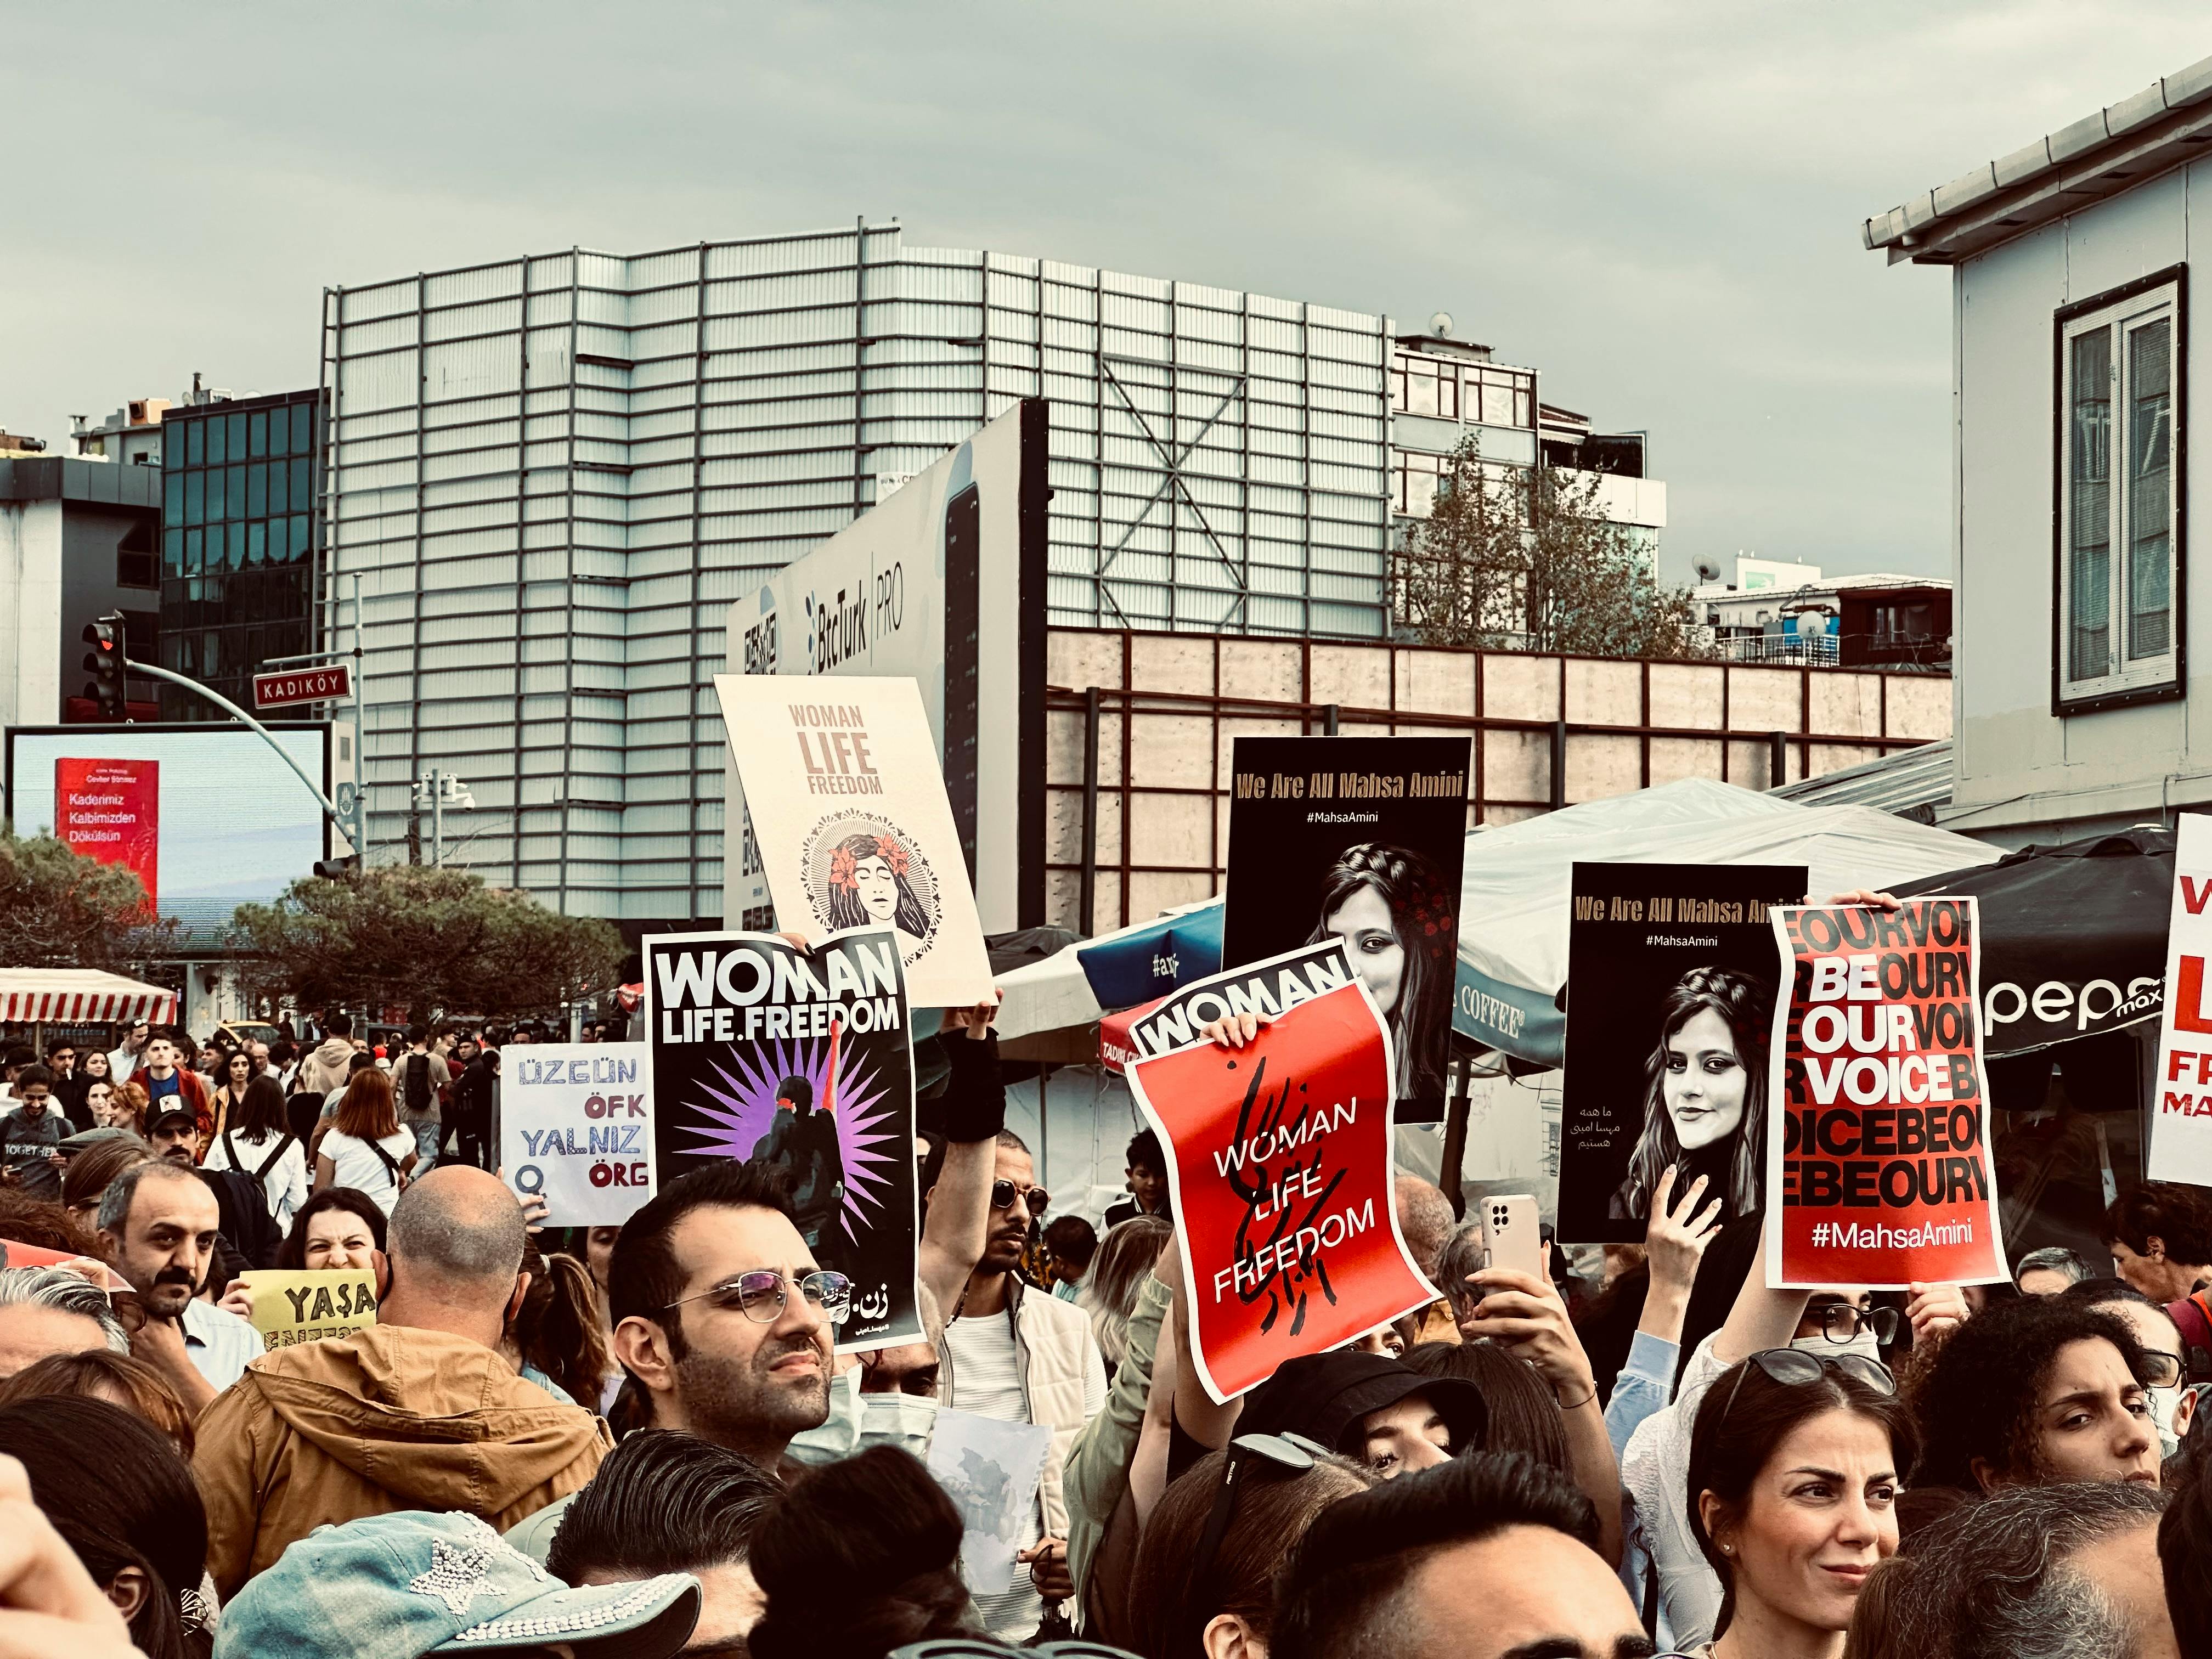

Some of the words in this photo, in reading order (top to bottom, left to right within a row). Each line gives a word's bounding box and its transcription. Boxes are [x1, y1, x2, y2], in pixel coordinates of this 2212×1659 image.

[818, 580, 866, 674] BtcTurk
[877, 561, 903, 640] PRO
[264, 674, 338, 698] KADIKÖY
[788, 704, 864, 727] WOMAN
[797, 732, 878, 775] LIFE
[807, 776, 883, 795] FREEDOM
[1237, 773, 1265, 799] We
[1271, 773, 1304, 799] Are
[1309, 772, 1334, 798] All
[1339, 772, 1403, 798] Mahsa
[1409, 770, 1463, 798] Amini
[1307, 811, 1378, 823] #MahsaAmini
[1576, 896, 1605, 921] We
[1610, 896, 1643, 922] Are
[1649, 898, 1672, 922] All
[1678, 898, 1742, 923] Mahsa
[1646, 935, 1718, 947] #MahsaAmini
[655, 942, 898, 1008] WOMAN
[1140, 954, 1349, 1054] WOMAN
[2117, 989, 2163, 1018] max
[519, 1057, 636, 1085] ÜZGÜN
[1602, 1106, 1611, 1116] ما
[520, 1126, 641, 1156] YALNIZ
[1214, 1097, 1357, 1178] WOMAN
[1252, 1164, 1323, 1221] LIFE
[1812, 1218, 1973, 1249] #MahsaAmini
[1214, 1198, 1374, 1303] FREEDOM
[284, 1283, 376, 1323] YAŞA
